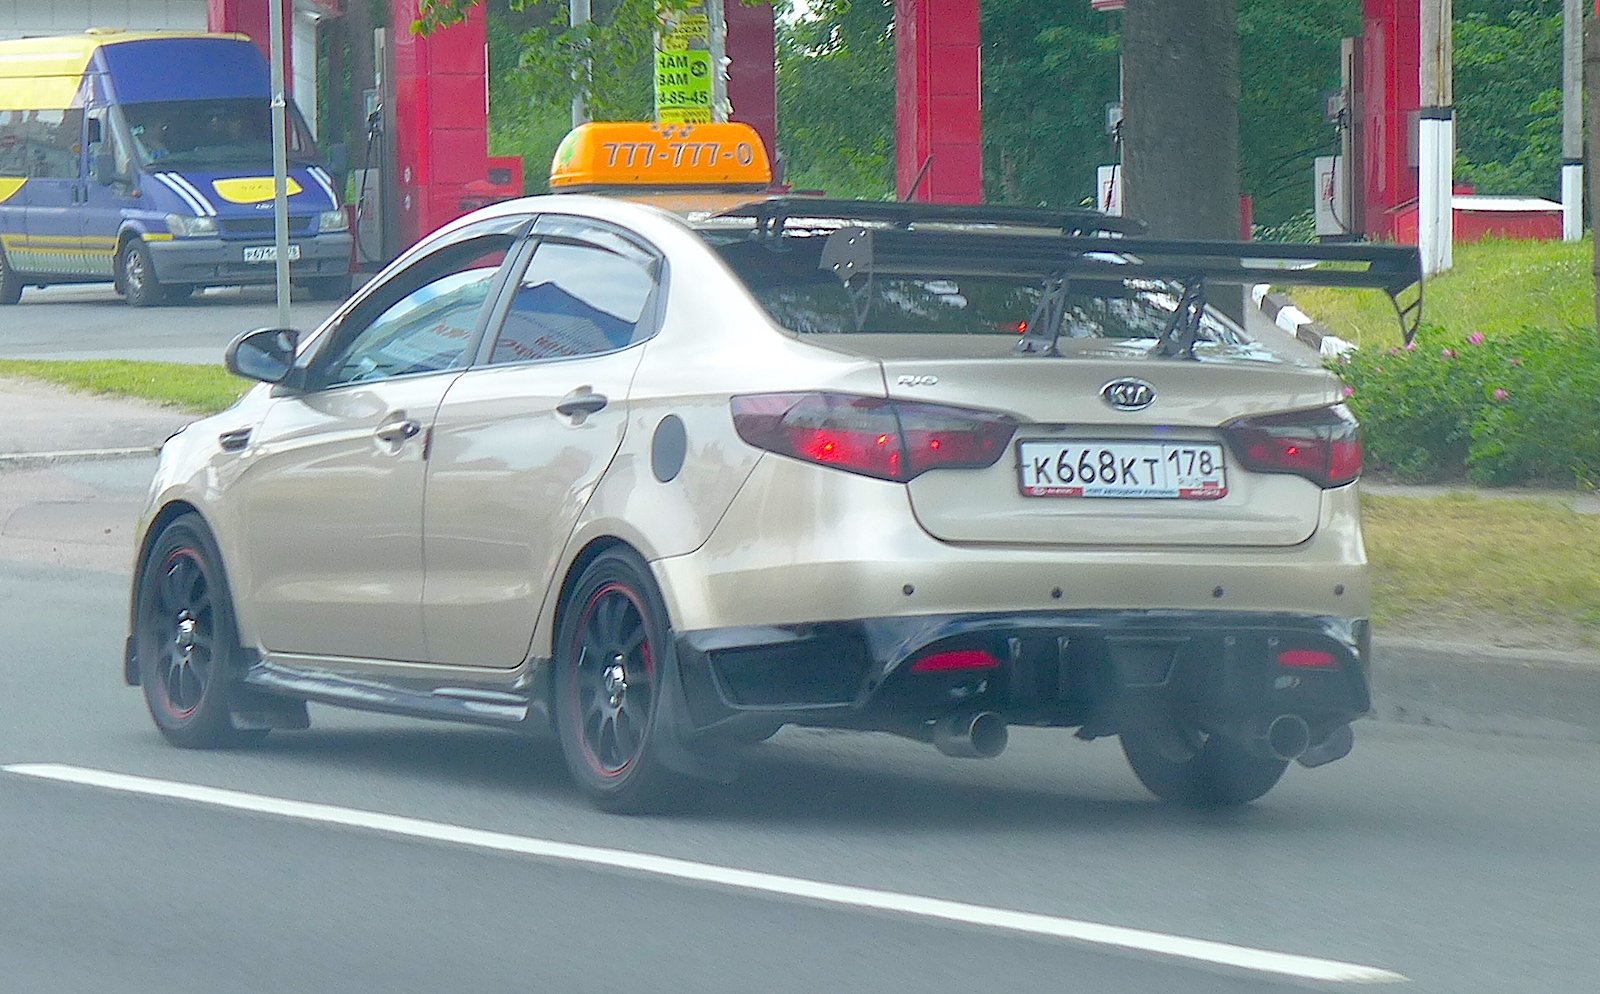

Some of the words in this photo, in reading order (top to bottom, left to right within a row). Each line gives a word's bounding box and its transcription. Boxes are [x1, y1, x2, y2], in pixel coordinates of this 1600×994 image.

[603, 142, 753, 168] 777-777-0
[1107, 383, 1149, 405] KIA
[1034, 449, 1159, 485] К668КТ
[1168, 449, 1213, 476] 178
